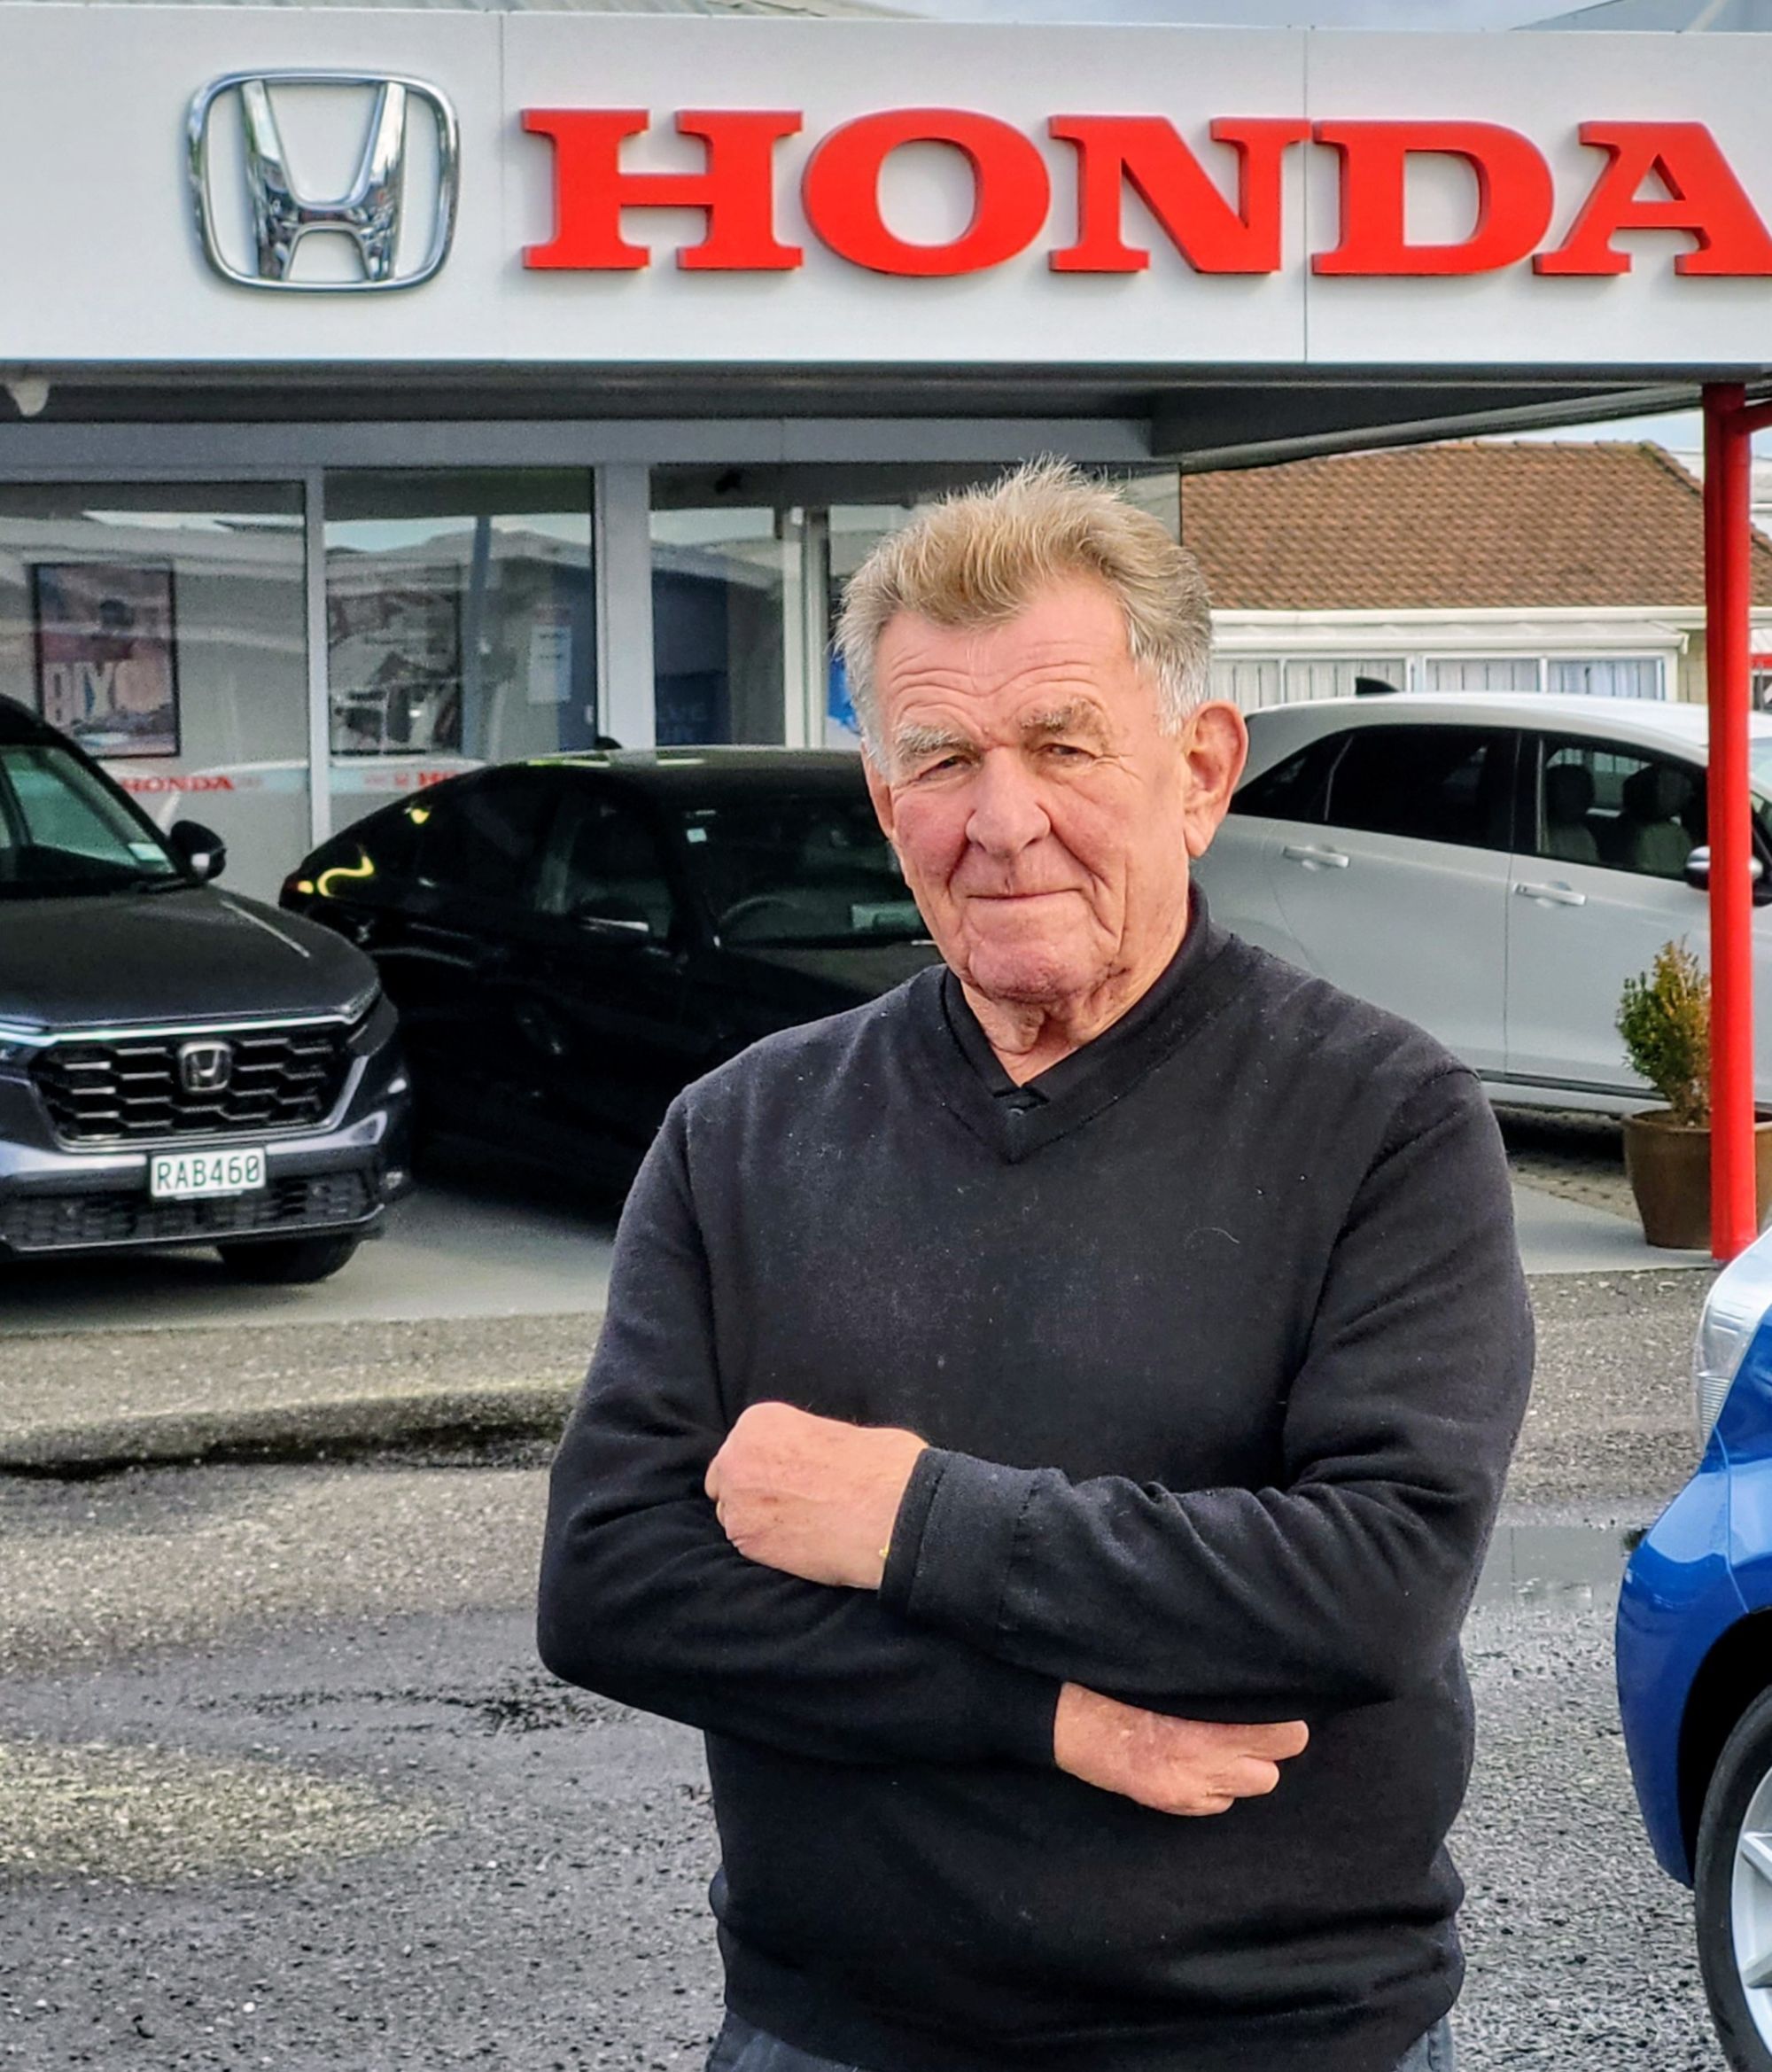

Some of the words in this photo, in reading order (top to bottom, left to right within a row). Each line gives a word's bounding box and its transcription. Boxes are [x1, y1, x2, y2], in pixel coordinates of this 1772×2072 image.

[521, 106, 1772, 277] HONDA
[120, 775, 234, 792] HONDA
[157, 1155, 260, 1190] RAB460
